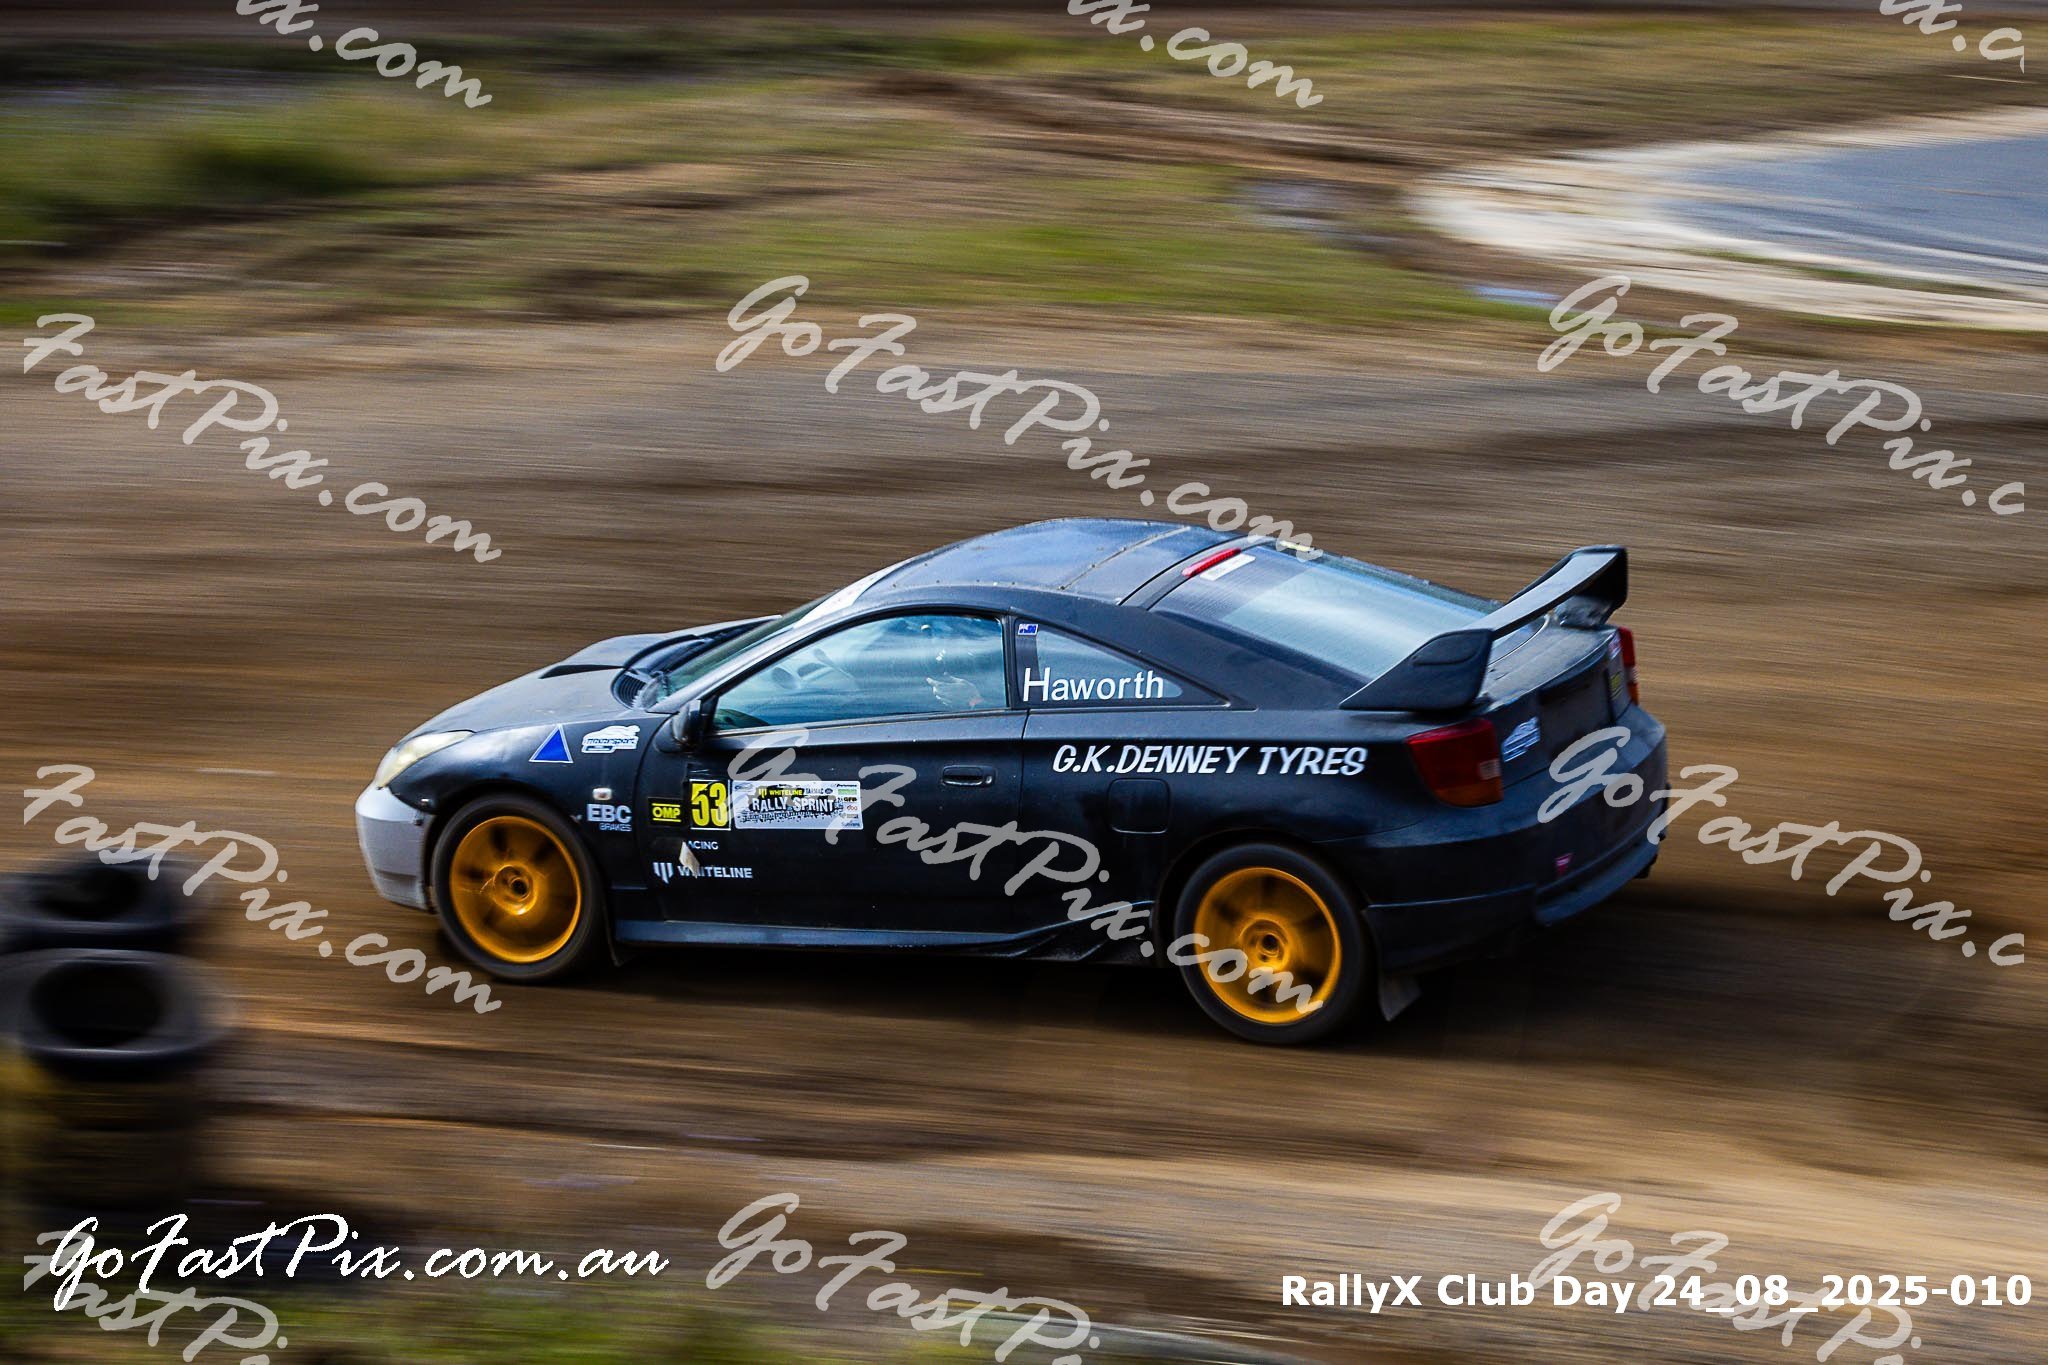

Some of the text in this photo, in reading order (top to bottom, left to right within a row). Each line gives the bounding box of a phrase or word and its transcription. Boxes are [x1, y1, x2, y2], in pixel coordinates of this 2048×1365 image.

[1022, 667, 1164, 702] Haworth
[1257, 746, 1368, 776] TYRES
[586, 803, 631, 823] EBC
[652, 806, 681, 820] OMP
[689, 781, 728, 828] 53
[752, 796, 834, 812] RALLY SPRINT
[600, 823, 633, 832] BRAKES
